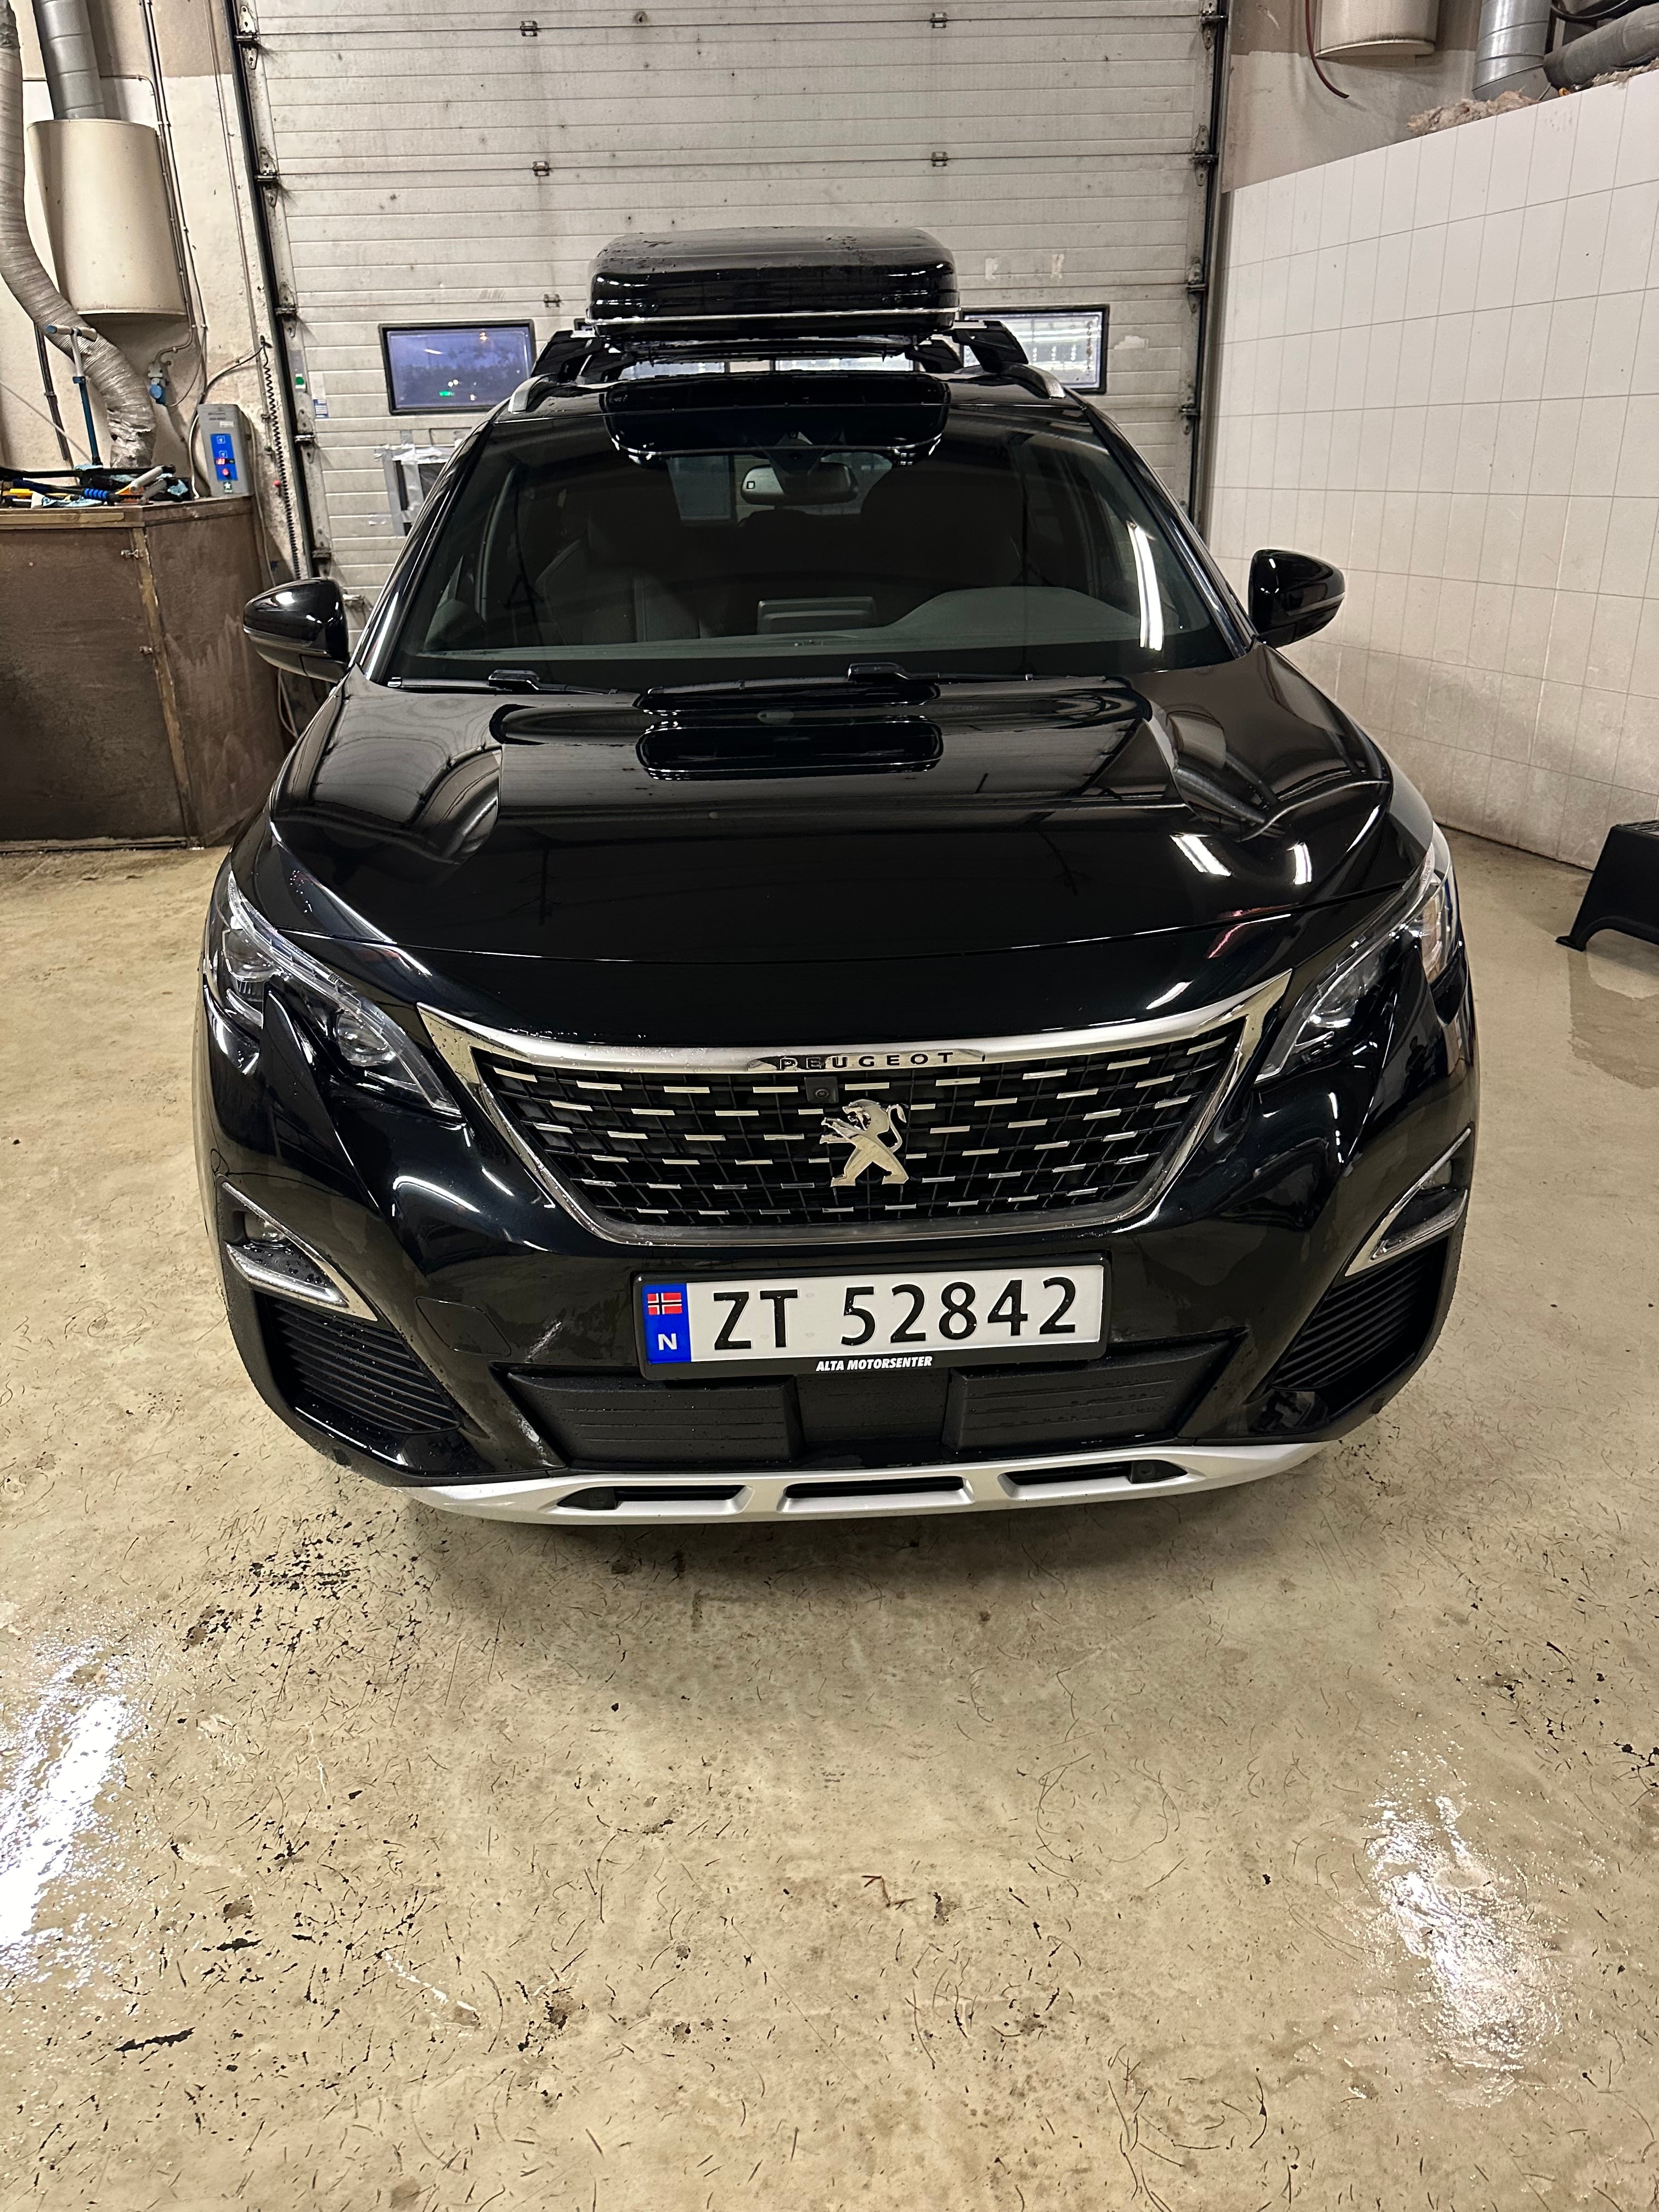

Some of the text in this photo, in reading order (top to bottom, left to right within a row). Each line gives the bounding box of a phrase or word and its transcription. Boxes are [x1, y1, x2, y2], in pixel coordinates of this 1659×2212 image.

[779, 1052, 953, 1071] PEUGEOT
[713, 1276, 1077, 1351] ZT 52842
[658, 1333, 678, 1351] N
[815, 1356, 933, 1372] ALTA MOTORSENTER
